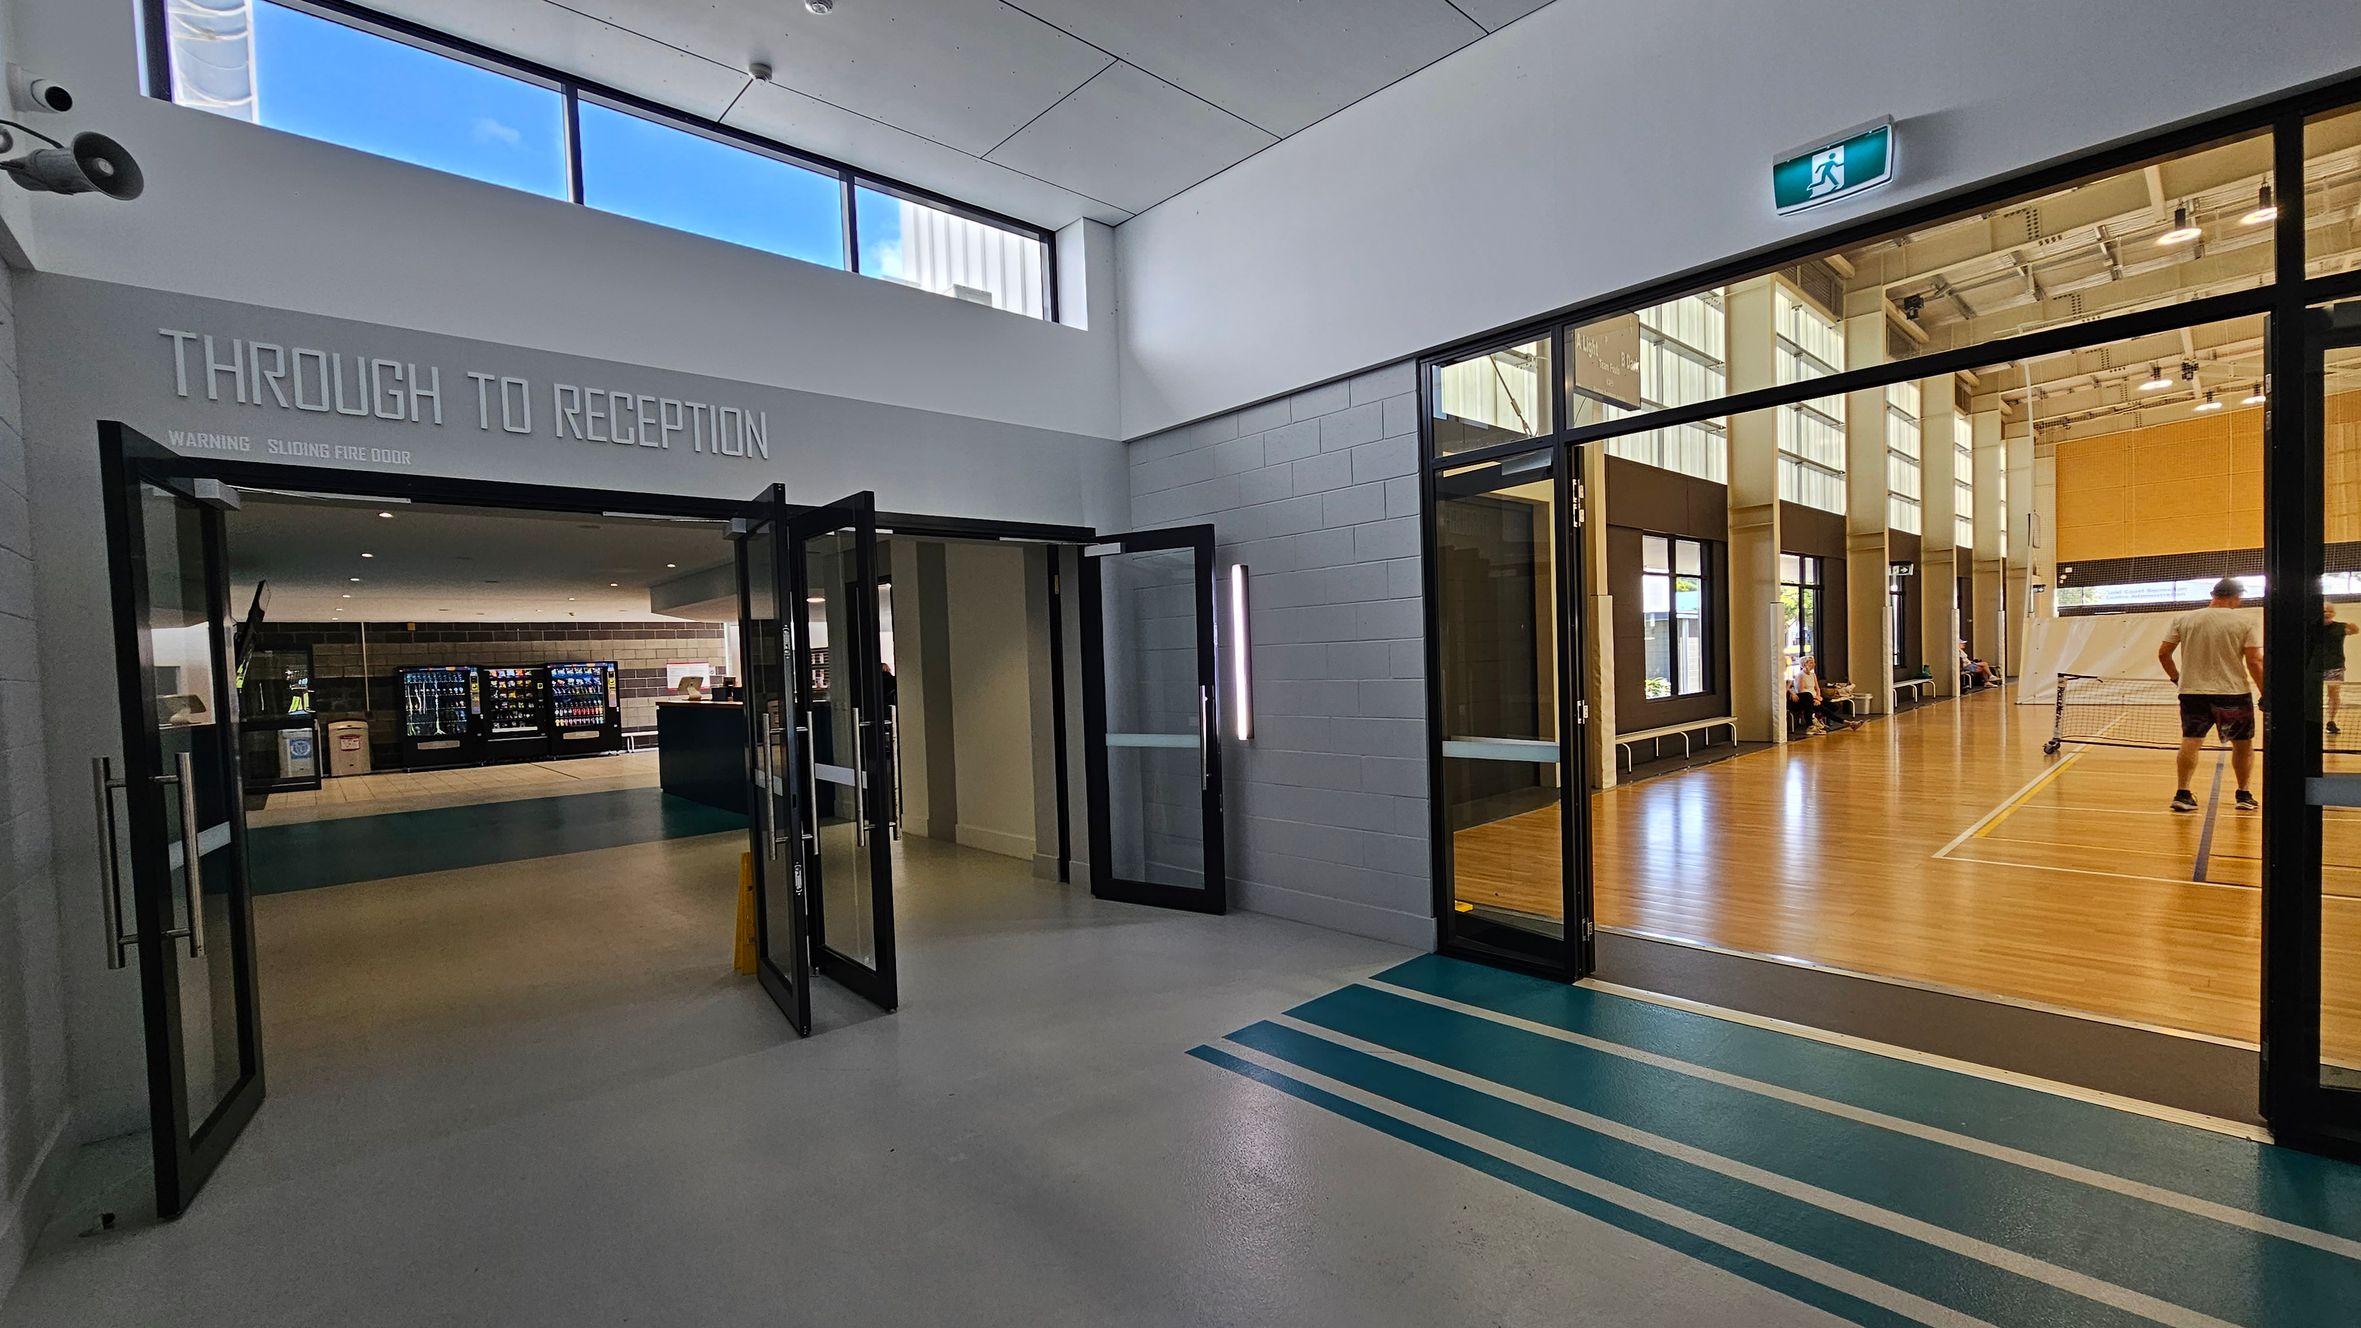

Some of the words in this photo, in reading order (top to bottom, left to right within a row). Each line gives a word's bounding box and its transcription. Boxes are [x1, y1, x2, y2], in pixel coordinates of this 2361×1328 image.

[158, 328, 442, 425] THROUGH
[467, 371, 531, 434] TO
[553, 383, 769, 460] RECEPTION
[168, 430, 250, 451] WARNING
[268, 439, 329, 459] SLIDING
[335, 446, 367, 462] FIRE
[371, 448, 412, 465] DOOR
